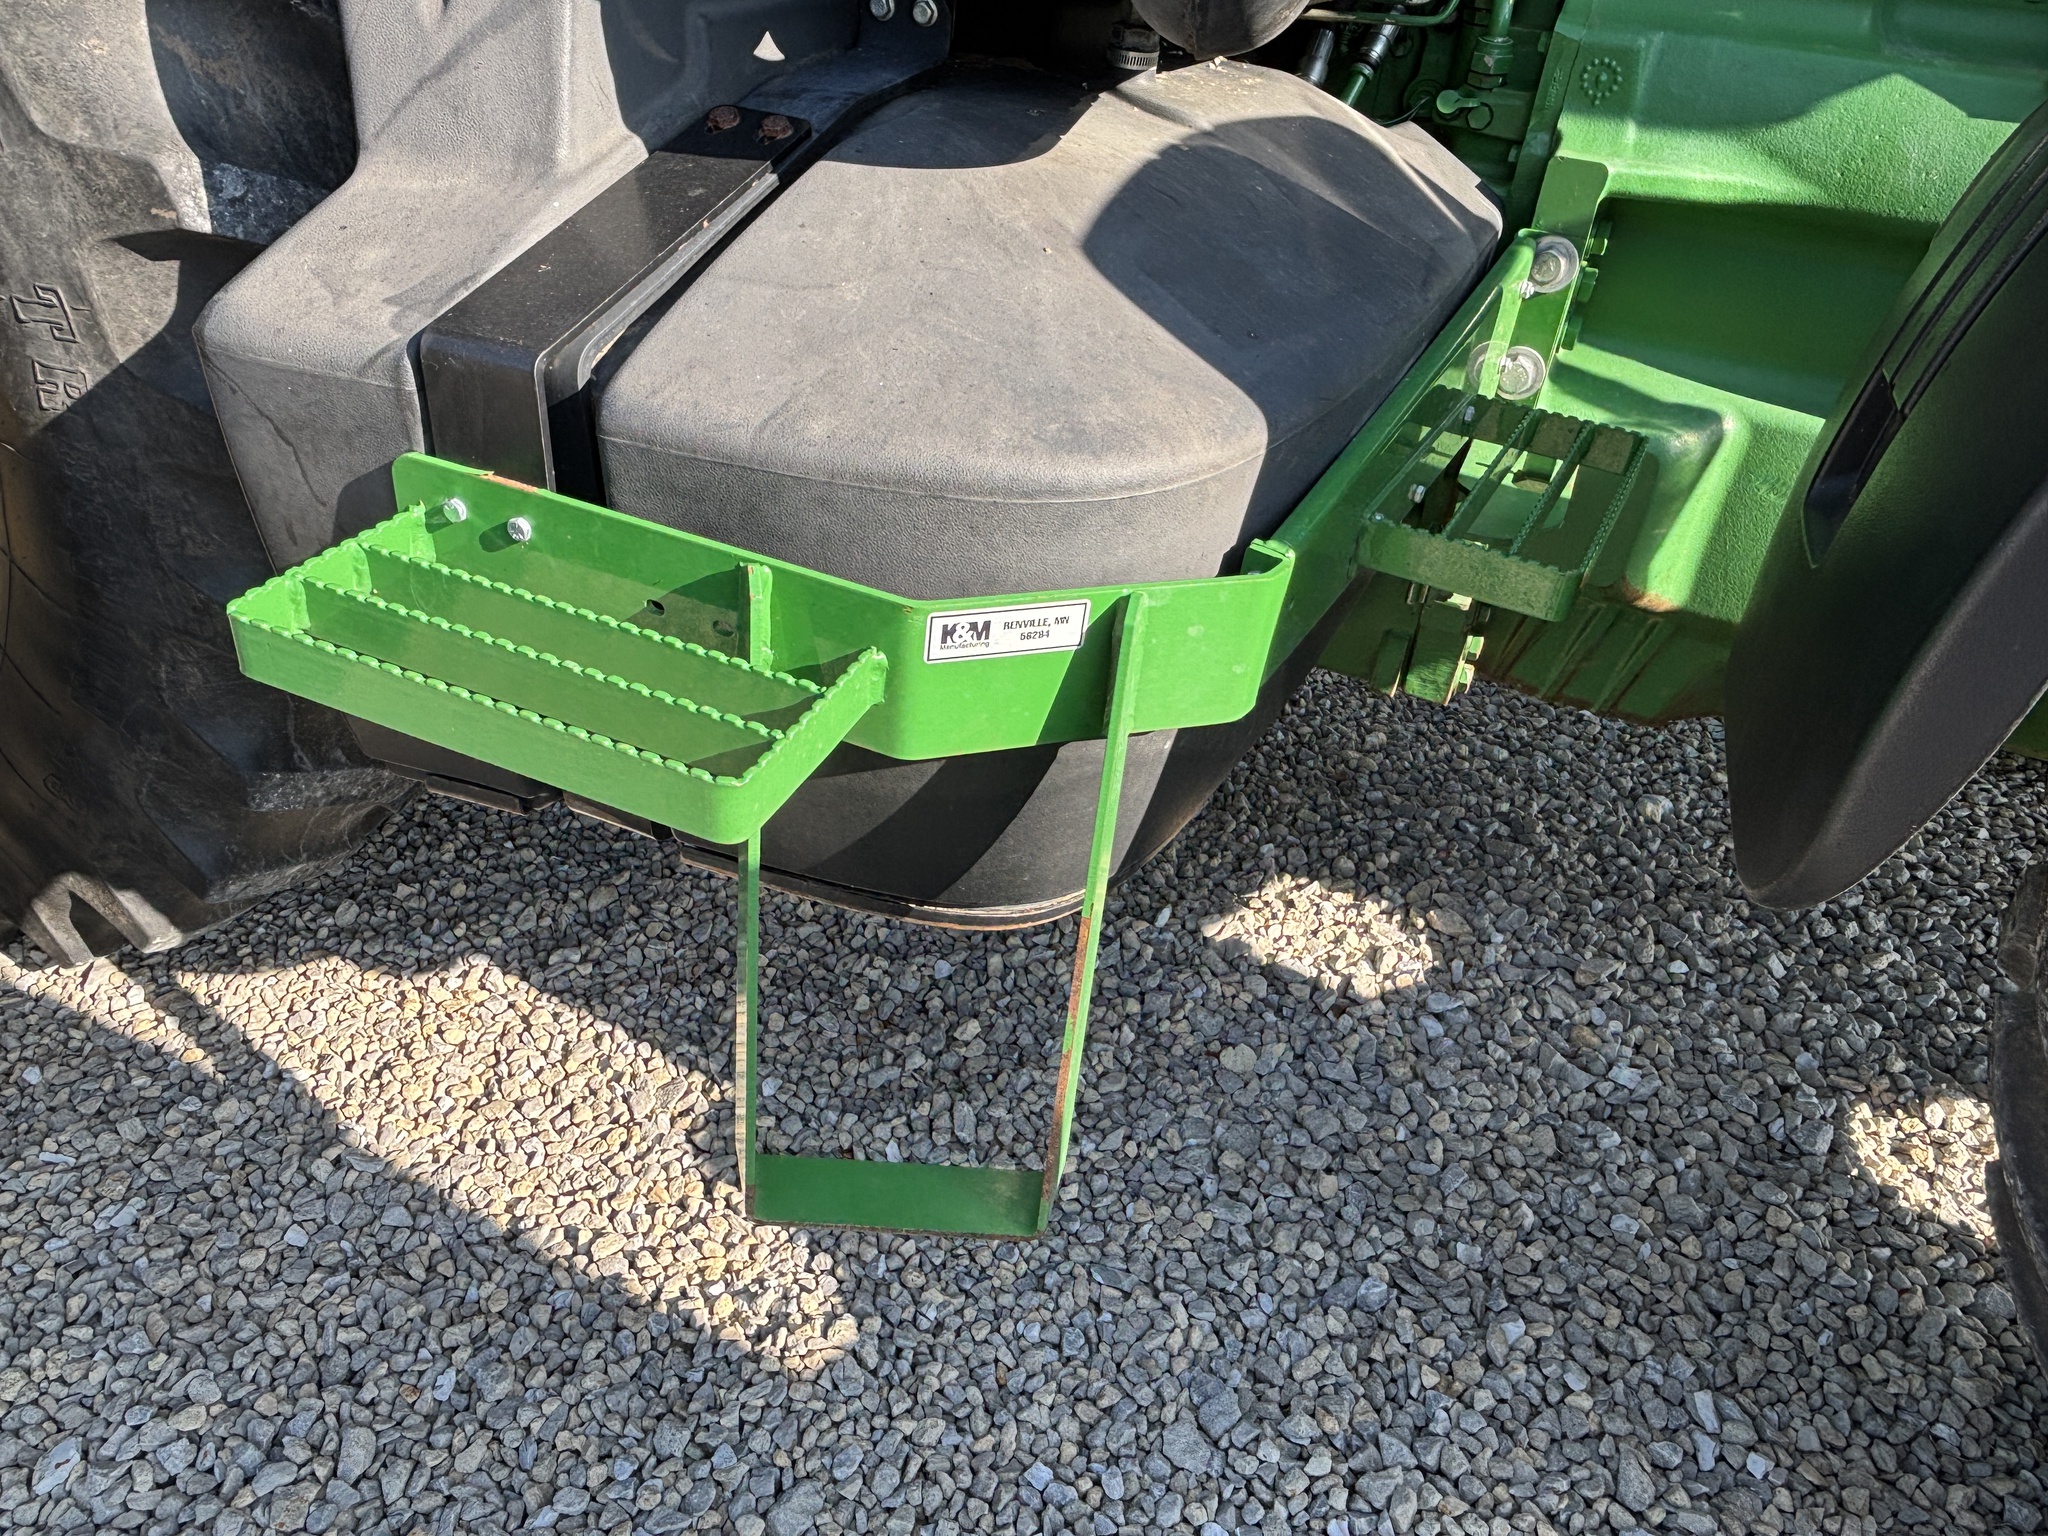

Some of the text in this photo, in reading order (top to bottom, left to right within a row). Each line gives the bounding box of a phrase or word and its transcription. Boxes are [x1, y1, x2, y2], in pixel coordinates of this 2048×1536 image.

[1003, 615, 1070, 631] RENVILLE, MN
[941, 620, 992, 645] K&M
[1019, 629, 1050, 641] 56284
[940, 640, 990, 651] Manufacturing
